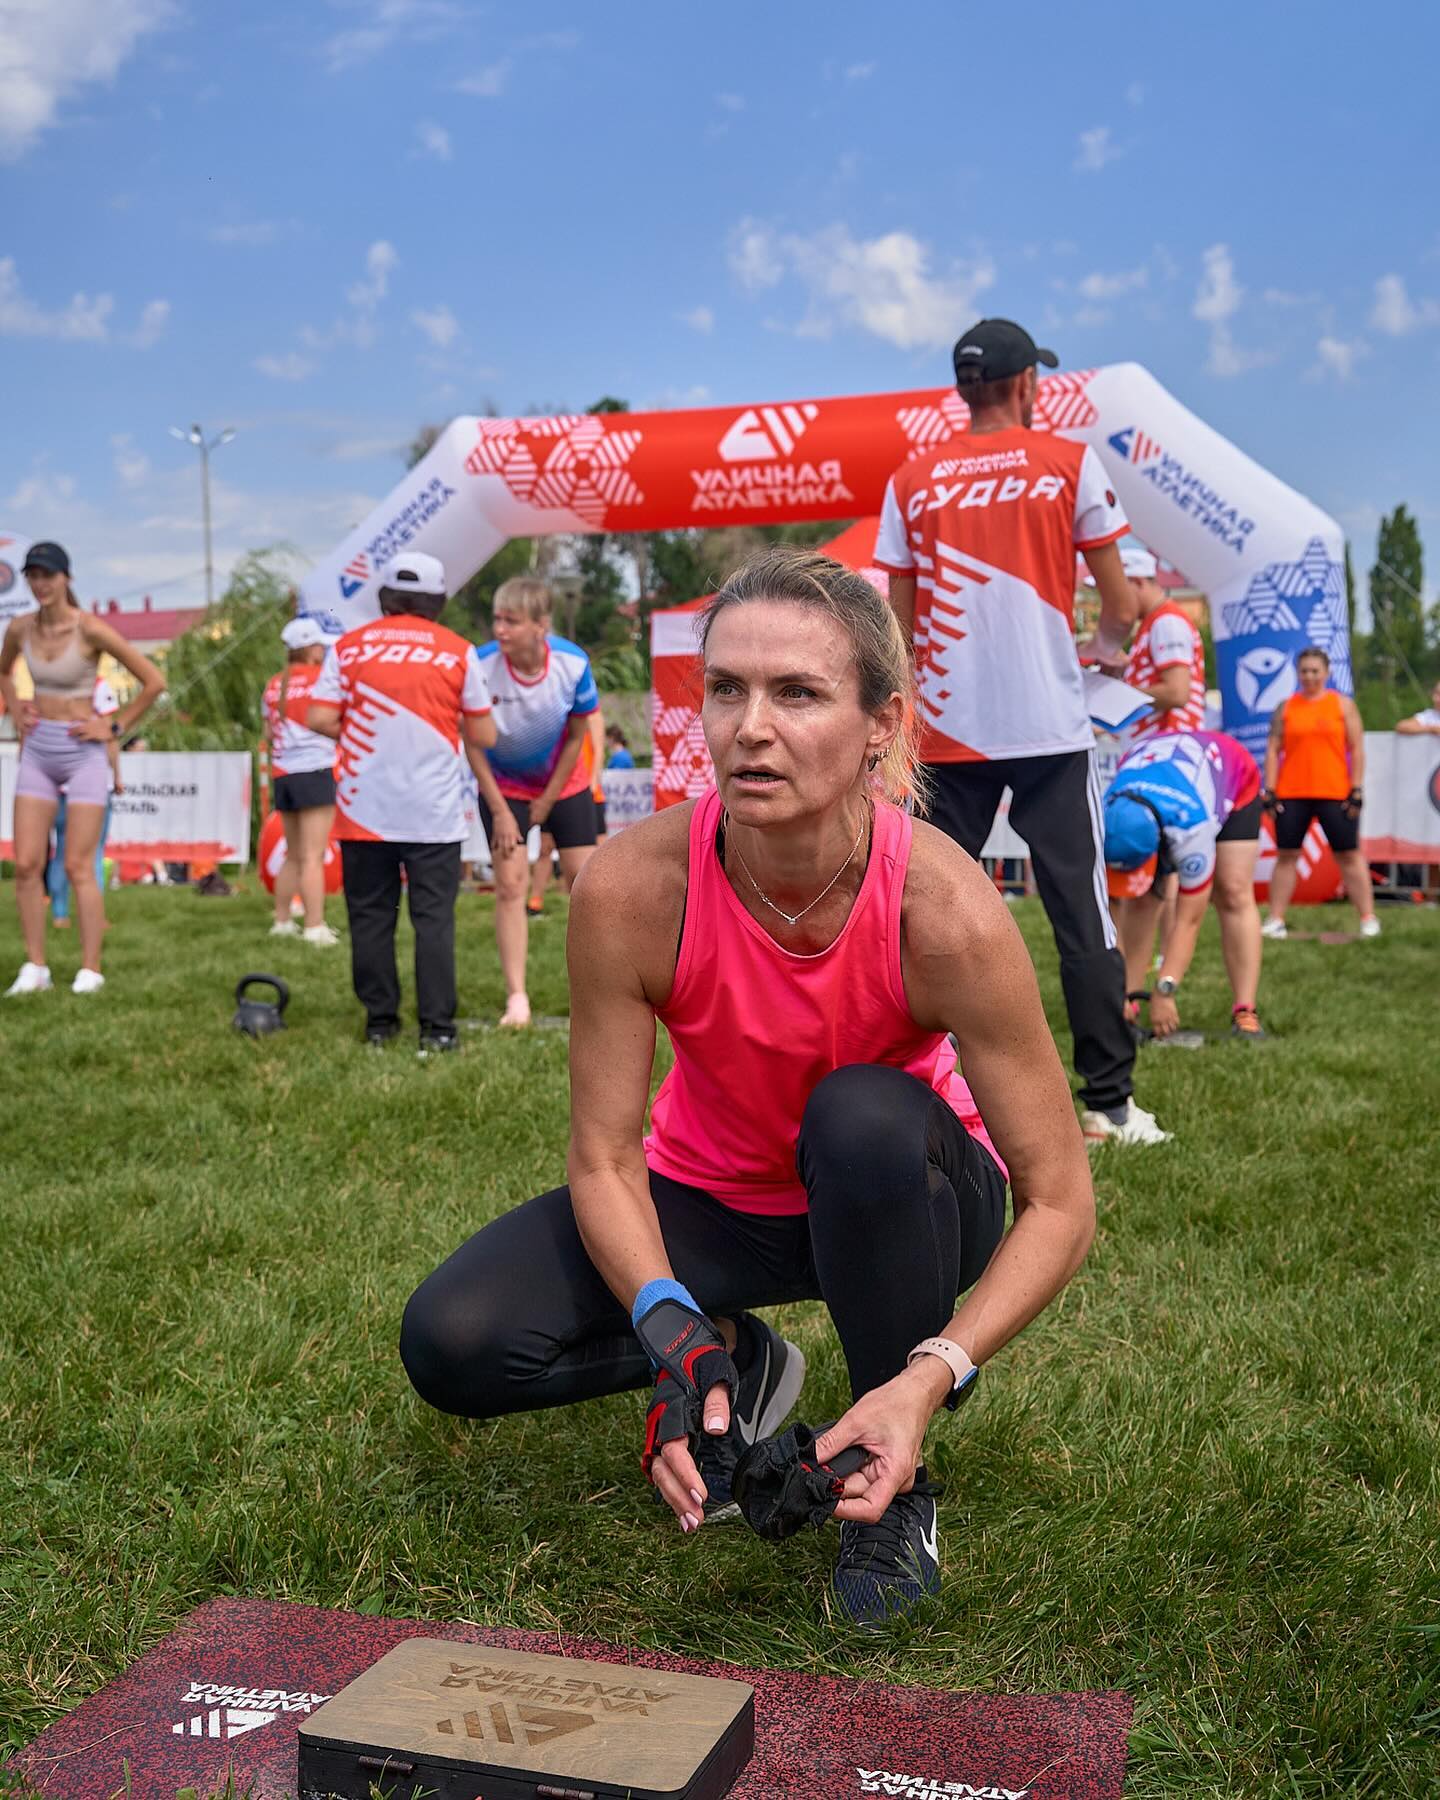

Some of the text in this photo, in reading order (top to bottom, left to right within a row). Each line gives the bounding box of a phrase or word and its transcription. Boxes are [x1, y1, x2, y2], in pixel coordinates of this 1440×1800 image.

[690, 460, 842, 492] УЛИЧНАЯ
[690, 483, 854, 512] АТЛЕТИКА
[907, 475, 1066, 522] СУДЬЯ
[1162, 452, 1255, 536] УЛИЧНАЯ
[1142, 466, 1244, 556] АТЛЕТИКА
[338, 643, 461, 670] СУДЬЯ
[121, 783, 199, 797] РАЛЬСКАЯ
[190, 1681, 335, 1704] АТЛЕТИКА
[440, 1675, 650, 1717] УЛИЧНАЯ
[450, 1662, 678, 1703] АТЛЕТИКА
[179, 1691, 312, 1713] УЛИЧНАЯ
[856, 1767, 1029, 1800] АТЛЕТИКА
